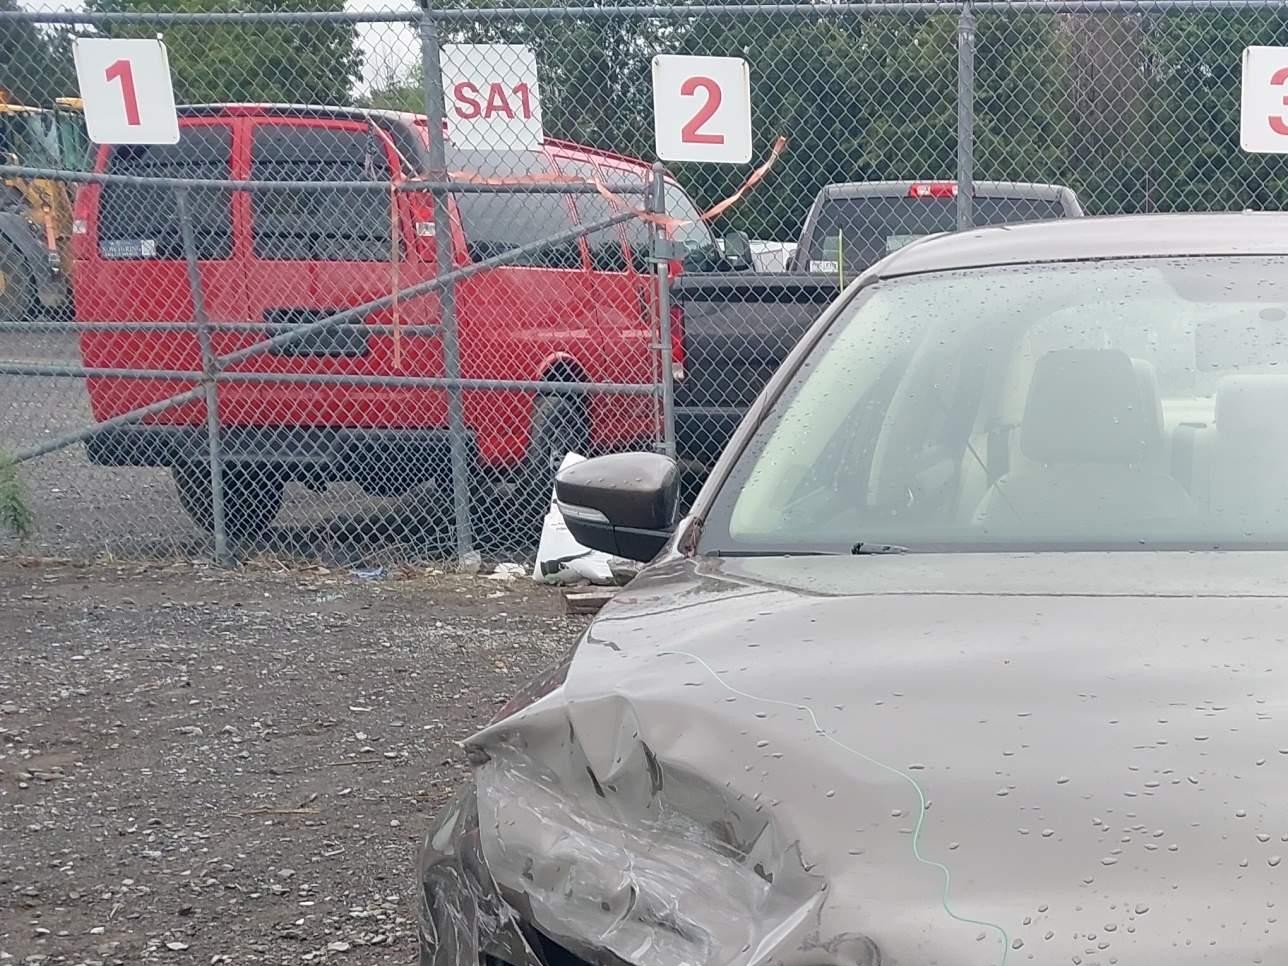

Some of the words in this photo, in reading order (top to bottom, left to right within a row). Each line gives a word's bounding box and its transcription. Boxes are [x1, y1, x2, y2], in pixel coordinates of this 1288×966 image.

[105, 59, 141, 125] 1
[453, 81, 532, 119] SA1
[680, 76, 725, 144] 2
